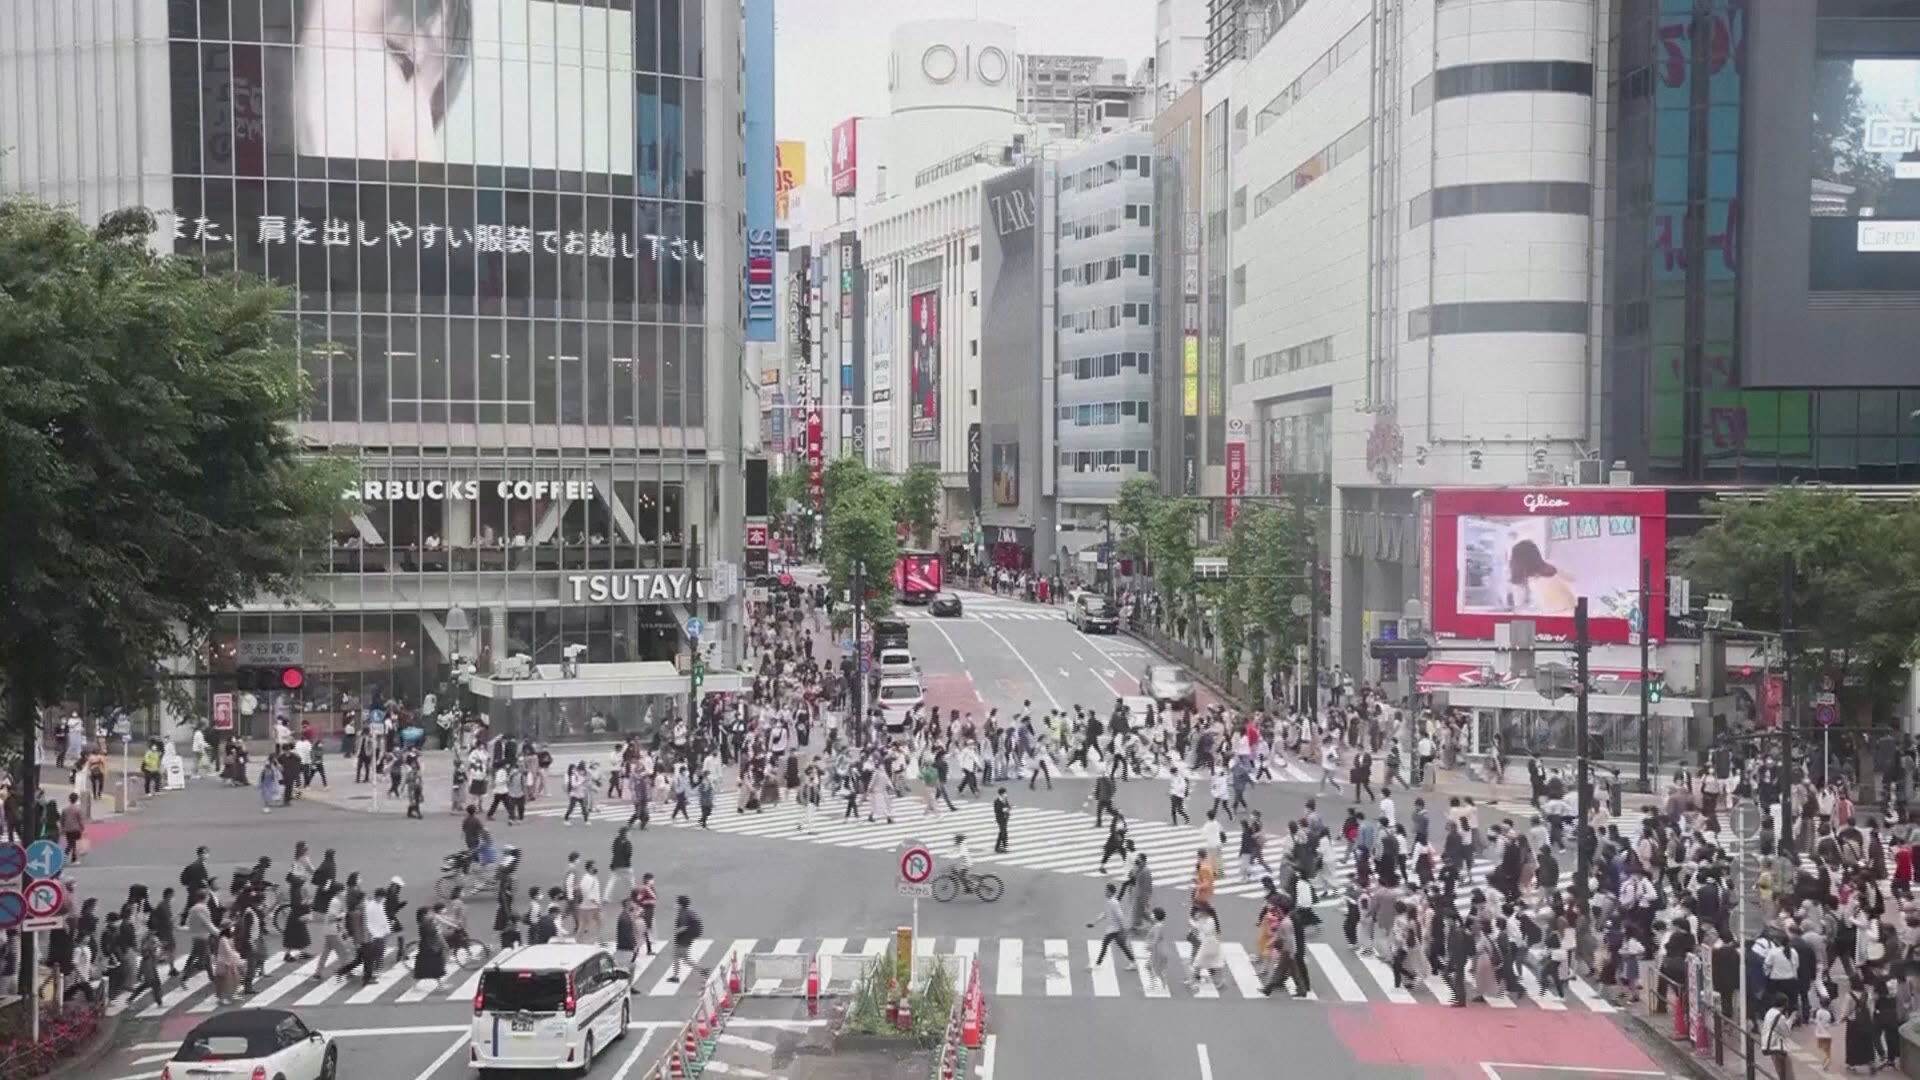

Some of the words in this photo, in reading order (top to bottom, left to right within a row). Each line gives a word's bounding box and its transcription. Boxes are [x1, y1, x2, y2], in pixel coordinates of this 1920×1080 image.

[749, 227, 773, 320] SEIBU
[970, 431, 980, 472] ZARA
[342, 480, 478, 500] ARBUCKS
[497, 480, 594, 500] COFFEE
[1523, 494, 1570, 512] Glico
[750, 530, 764, 545] 本
[568, 573, 704, 601] TSUTAYA
